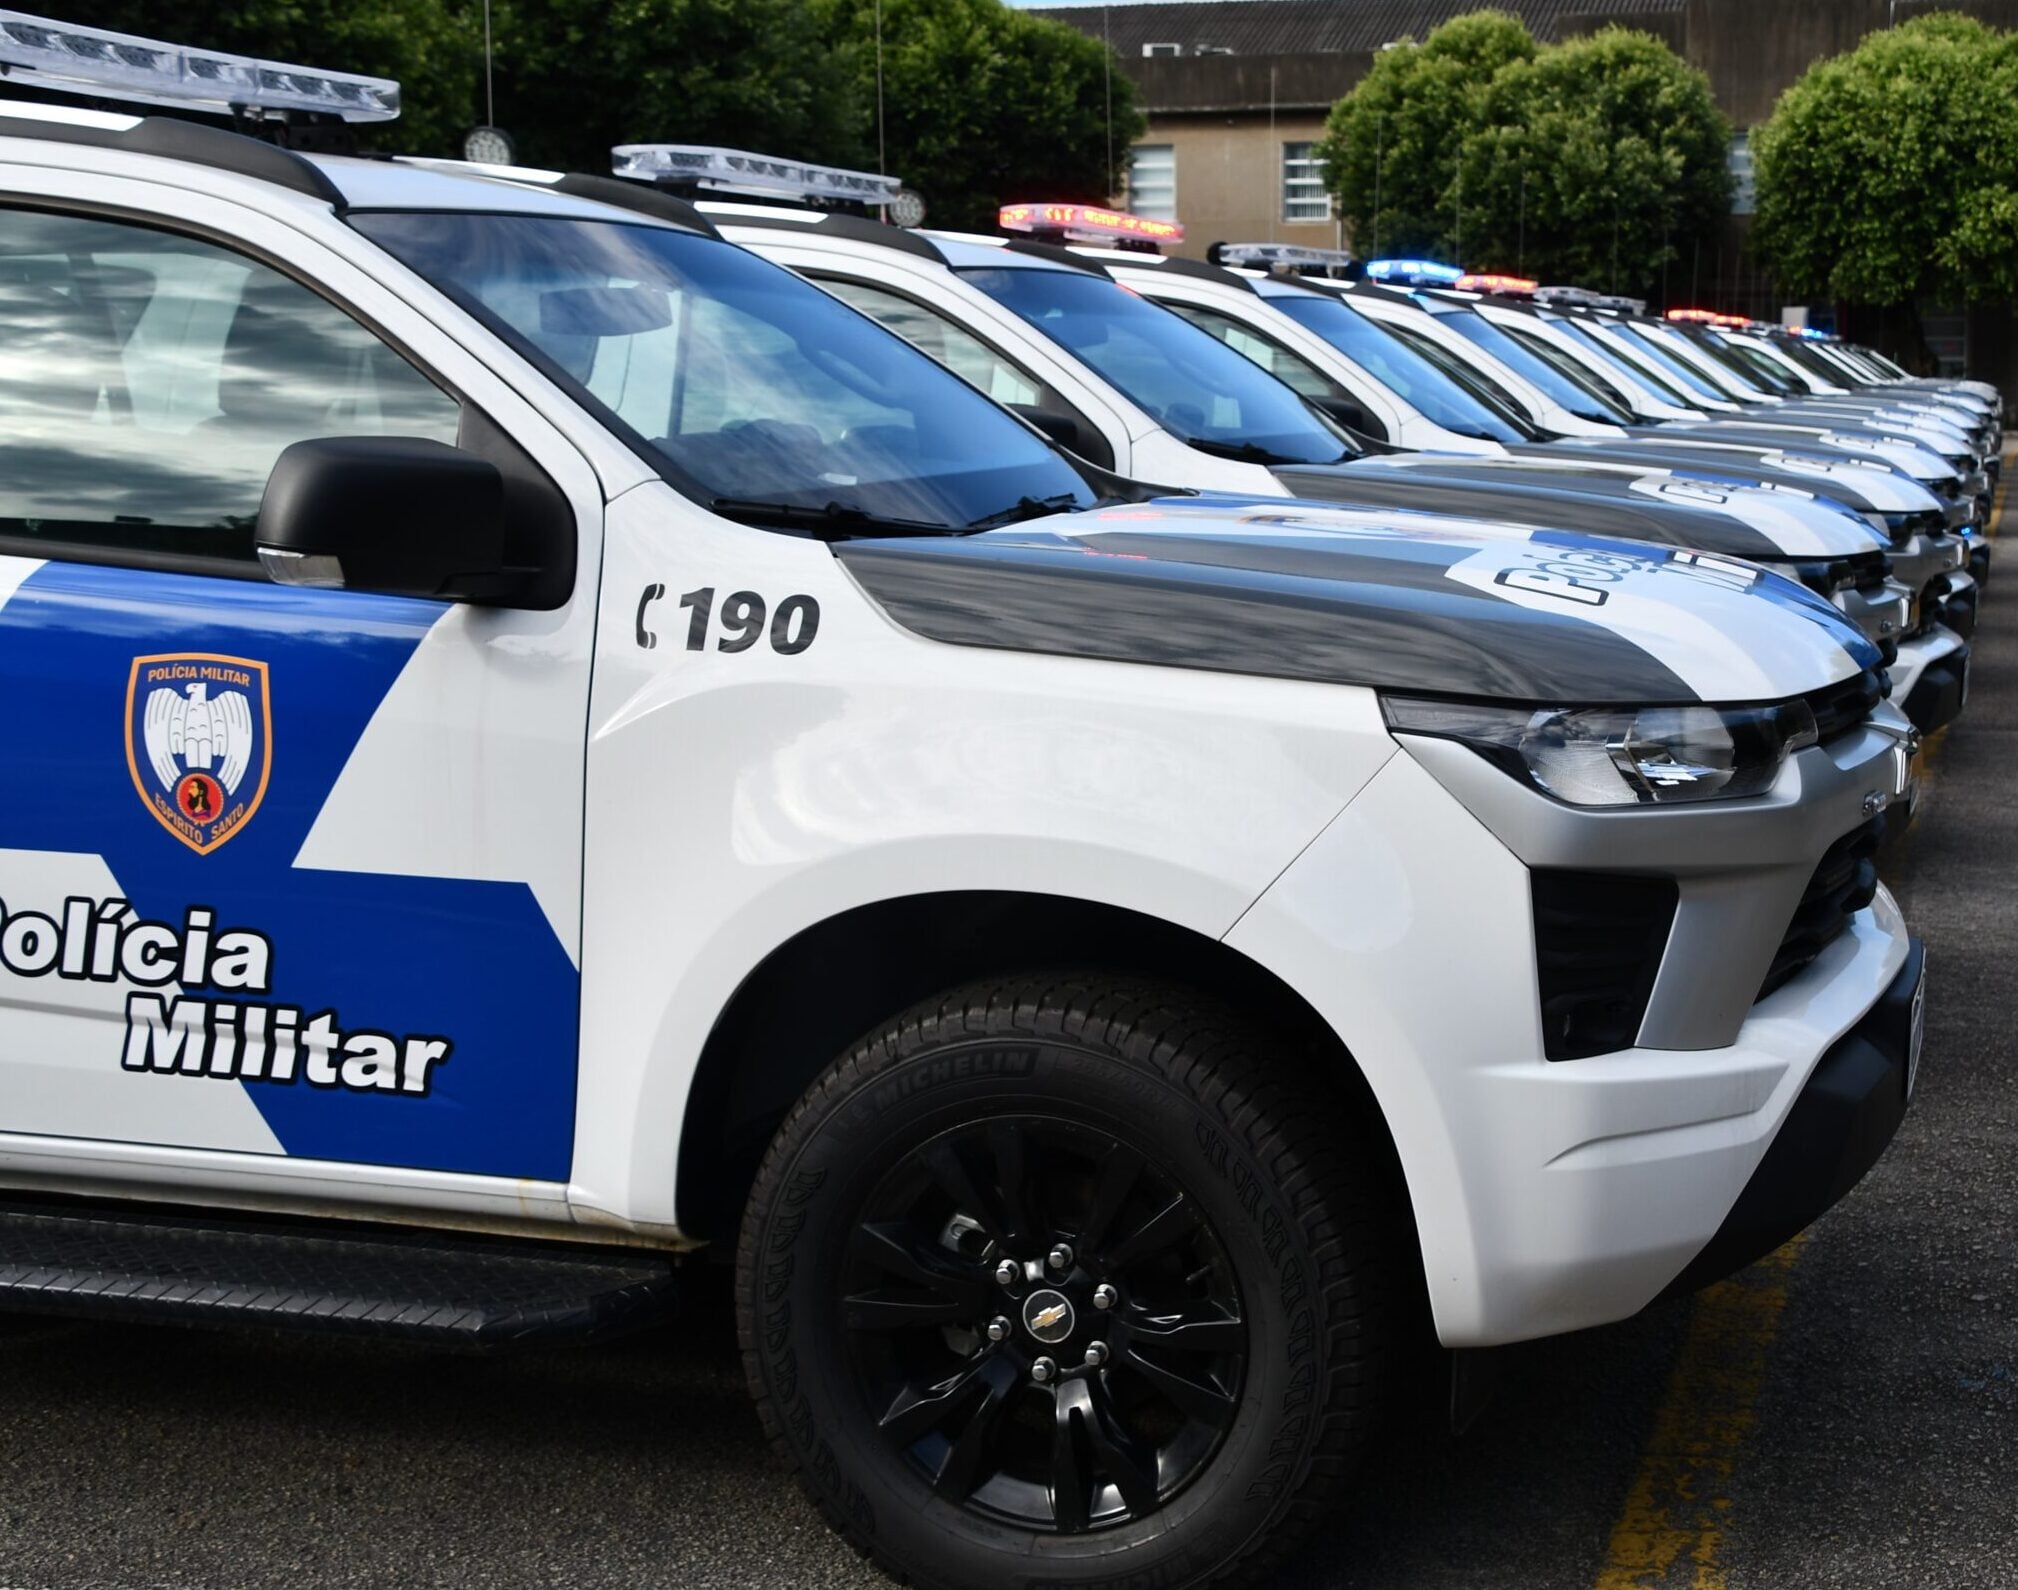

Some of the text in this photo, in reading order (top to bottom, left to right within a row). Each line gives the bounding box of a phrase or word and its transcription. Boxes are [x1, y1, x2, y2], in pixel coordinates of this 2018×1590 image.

[679, 587, 820, 656] 190
[148, 663, 250, 687] POLÍCIA MILITAR
[211, 802, 244, 840] SANTO
[0, 896, 274, 995] olícia
[121, 991, 454, 1098] Militar
[873, 1051, 1031, 1111] MICHELIN
